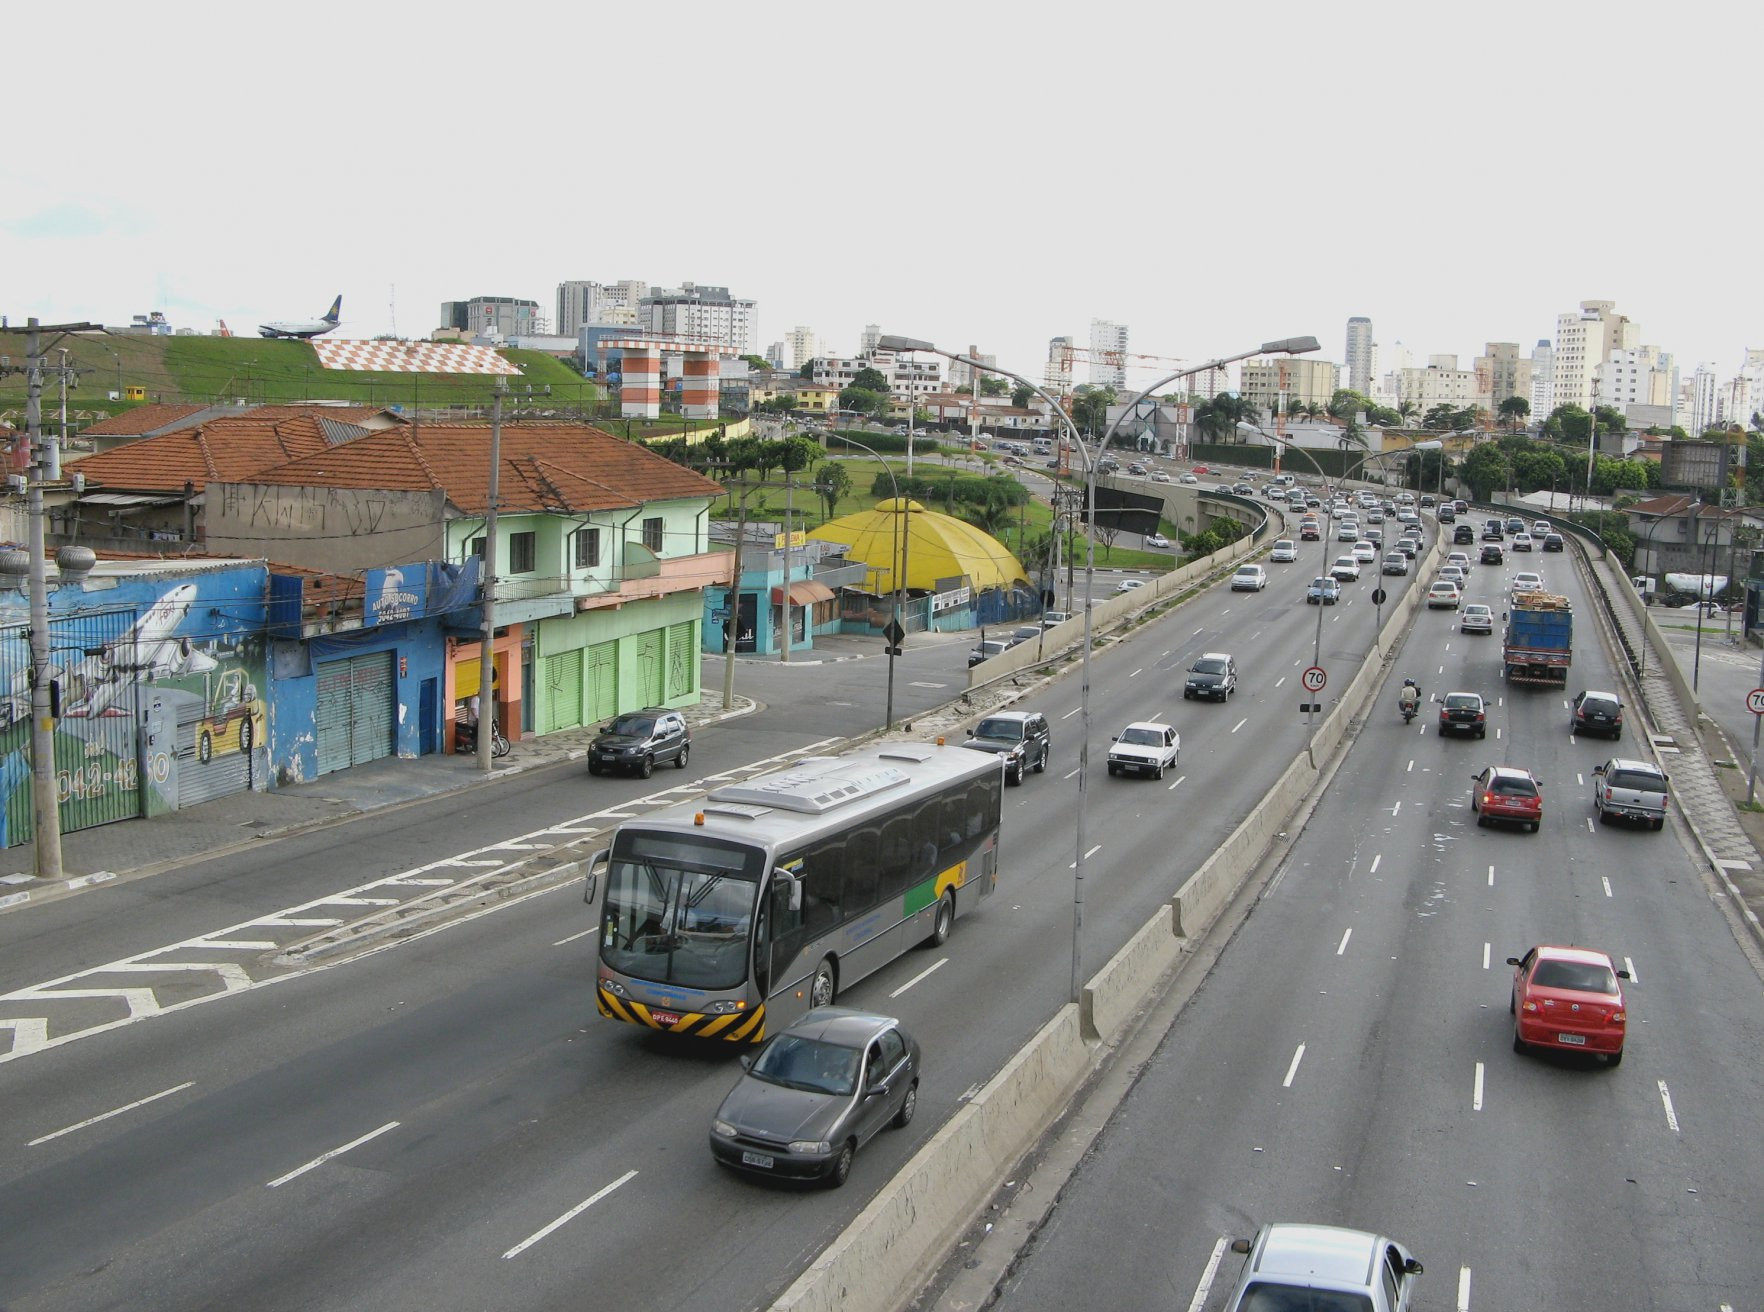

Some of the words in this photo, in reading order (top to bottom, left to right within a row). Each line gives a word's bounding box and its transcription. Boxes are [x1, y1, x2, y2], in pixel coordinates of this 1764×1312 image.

[372, 595, 390, 612] AUTO
[391, 592, 419, 606] SOCORRO
[1308, 672, 1324, 684] 70
